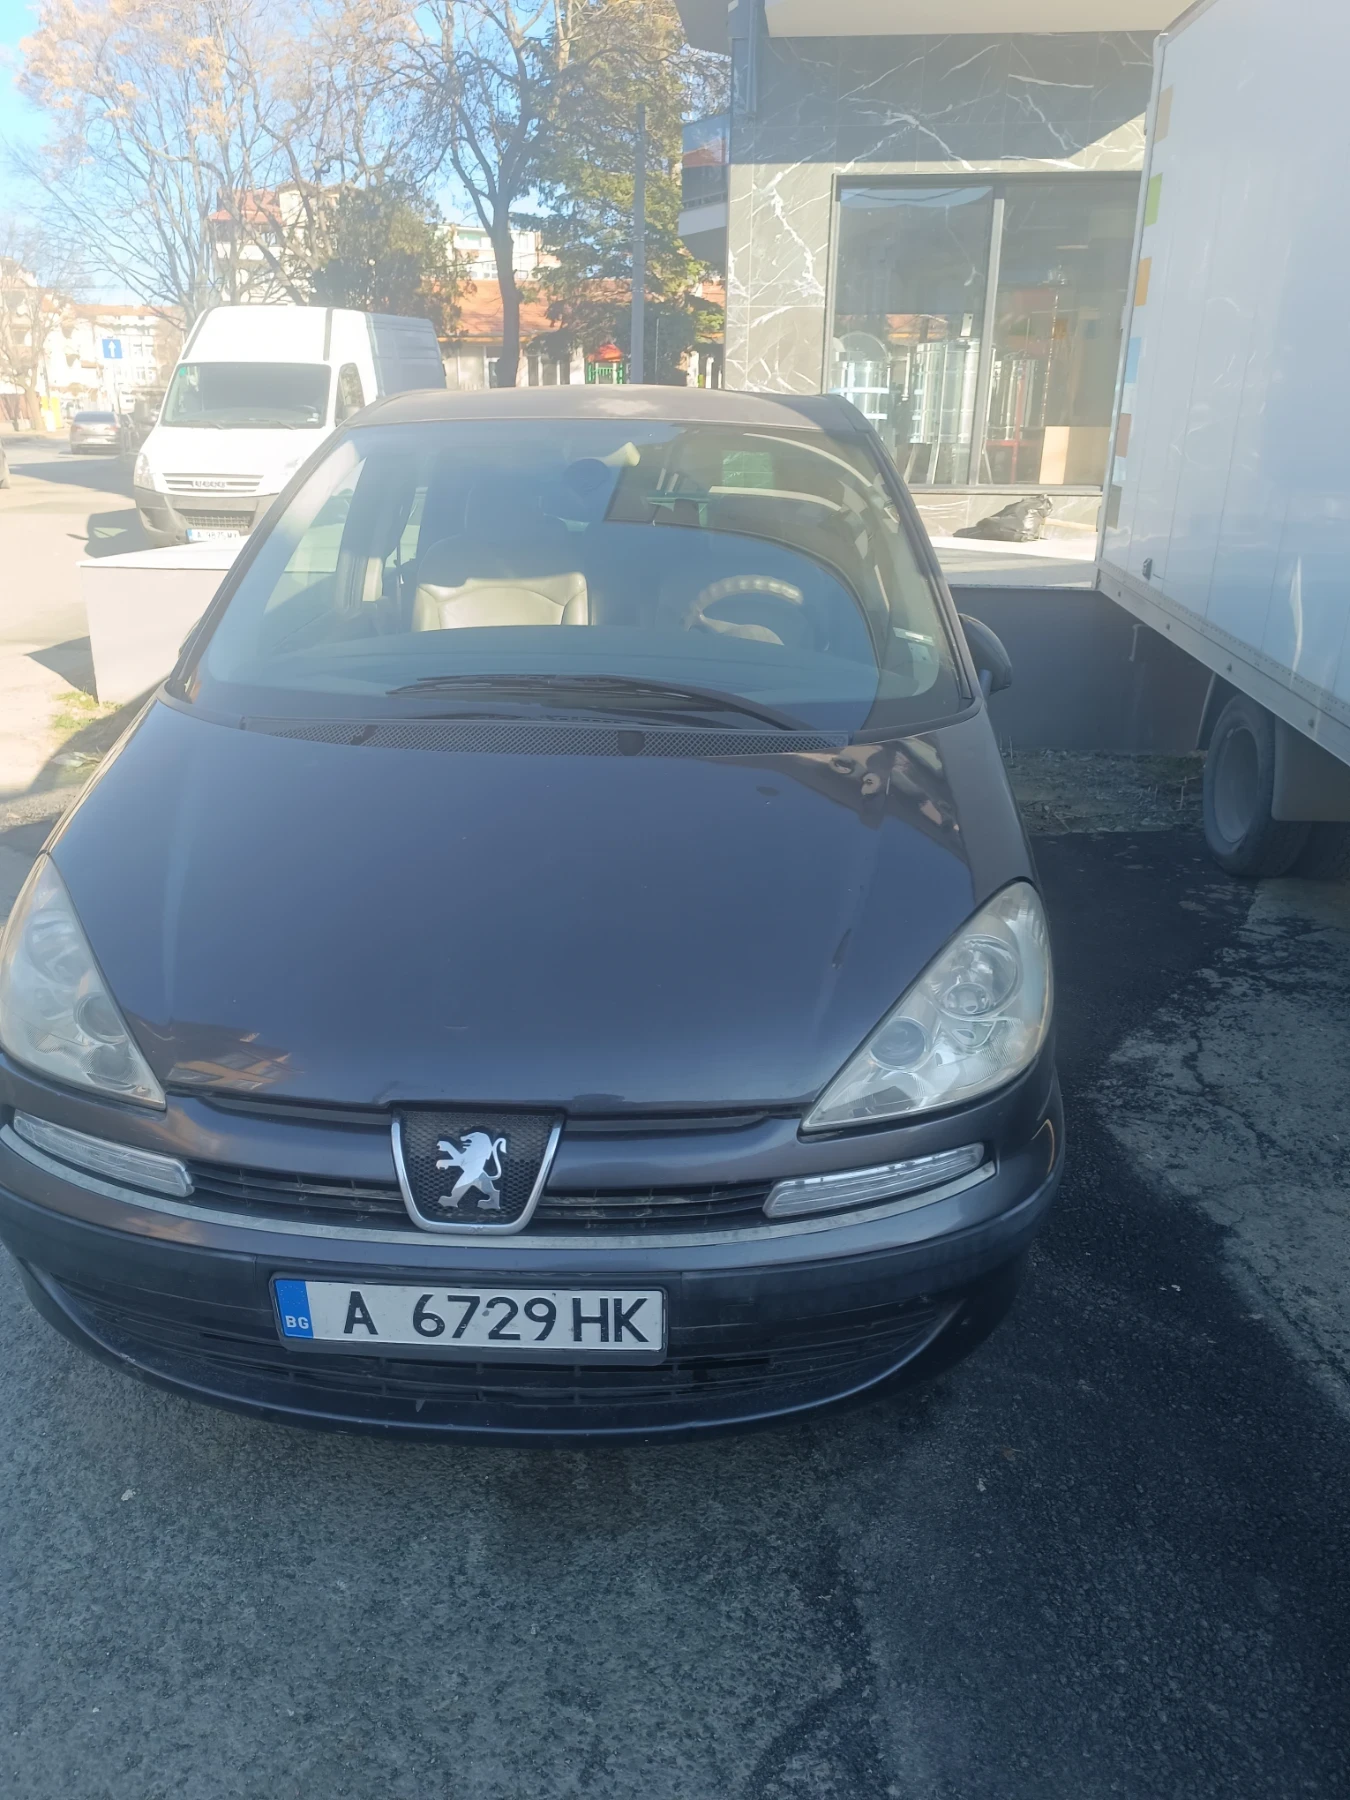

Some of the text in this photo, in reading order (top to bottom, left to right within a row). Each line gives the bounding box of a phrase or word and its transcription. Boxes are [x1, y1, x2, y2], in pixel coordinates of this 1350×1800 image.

[285, 1316, 309, 1330] BG
[343, 1290, 650, 1342] A 6729 HK
